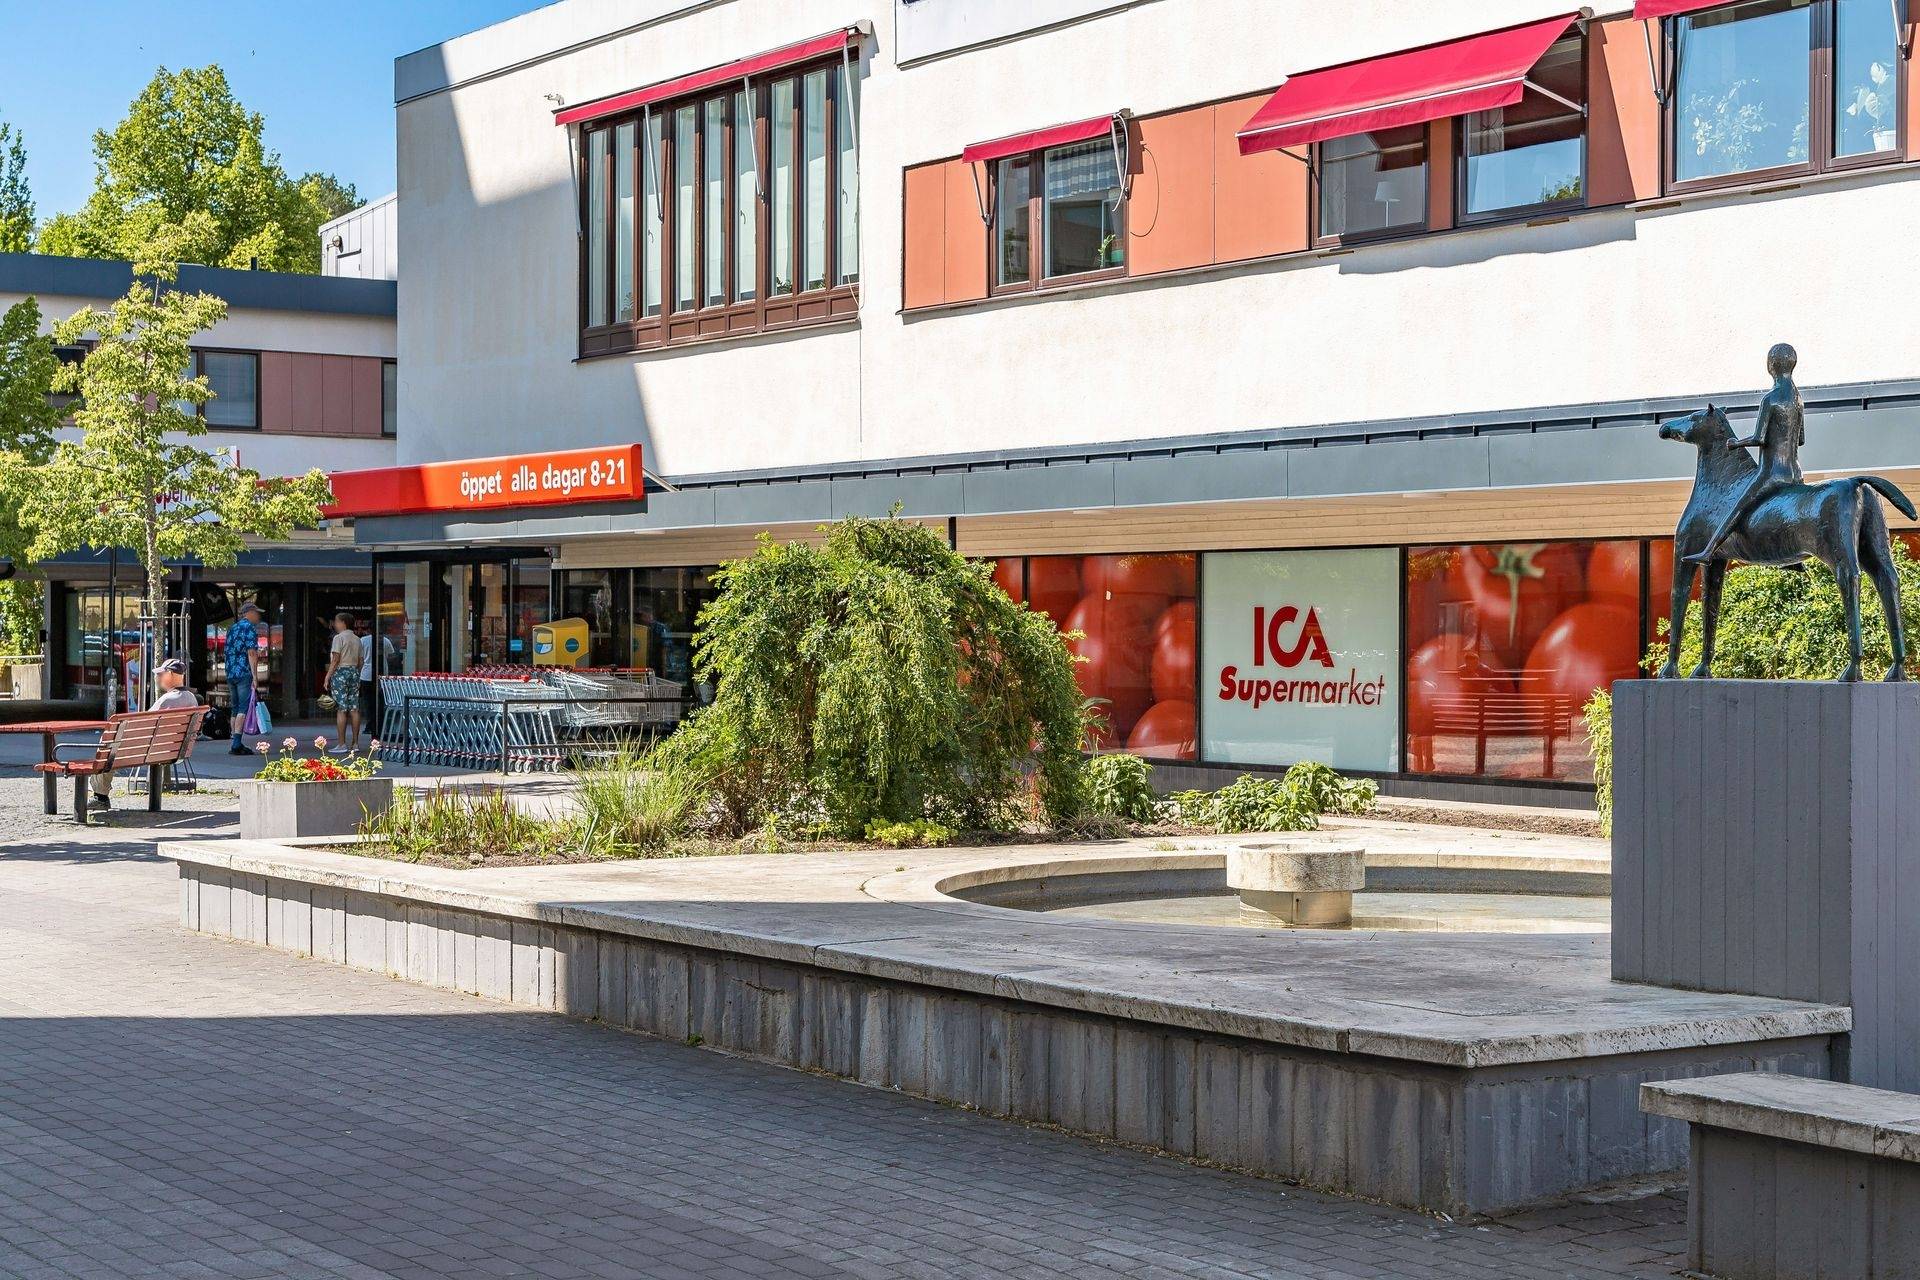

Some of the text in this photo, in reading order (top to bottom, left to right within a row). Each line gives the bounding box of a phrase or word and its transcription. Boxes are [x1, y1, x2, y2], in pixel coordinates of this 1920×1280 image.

[460, 458, 625, 502] öppet alla dagar 8-21
[1253, 605, 1335, 668] ICA
[1219, 665, 1385, 709] Supermarket
